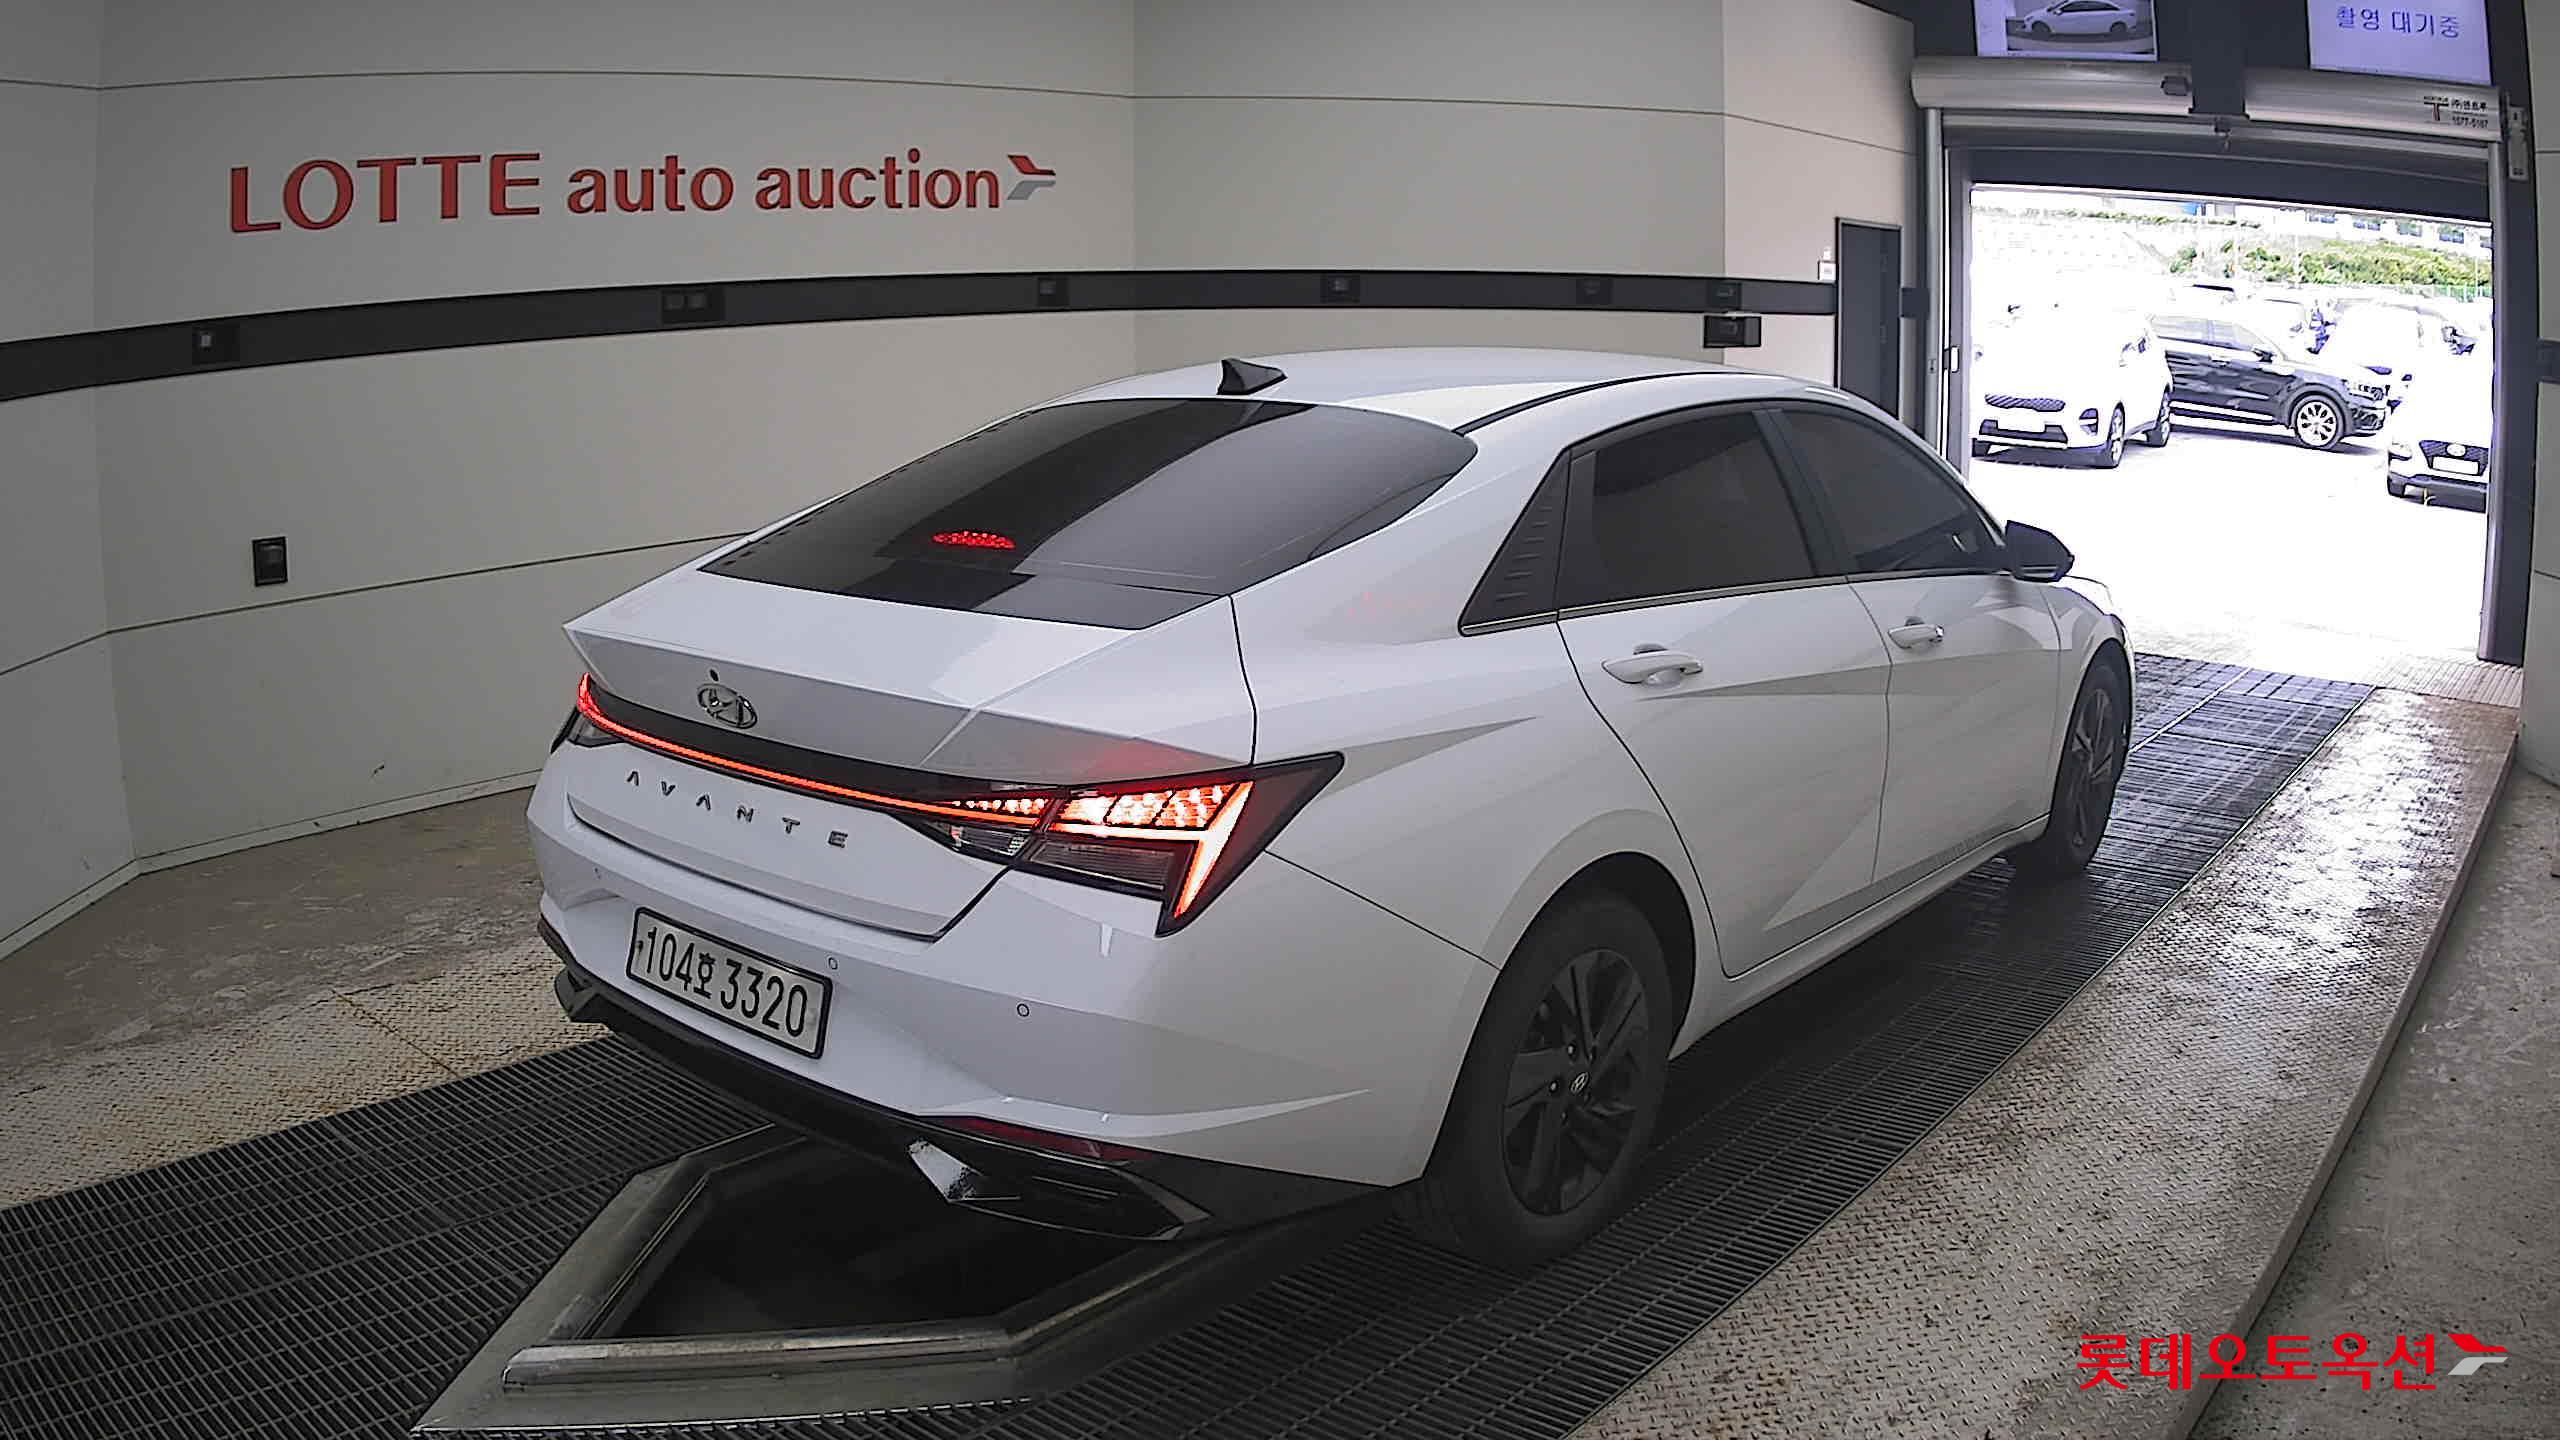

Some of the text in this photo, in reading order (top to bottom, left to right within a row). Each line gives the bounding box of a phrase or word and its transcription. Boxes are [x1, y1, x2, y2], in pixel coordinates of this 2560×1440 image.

[2336, 6, 2459, 39] 촬영 대기중
[231, 148, 1000, 233] LOTTE auto auction
[626, 770, 849, 849] AVANTE
